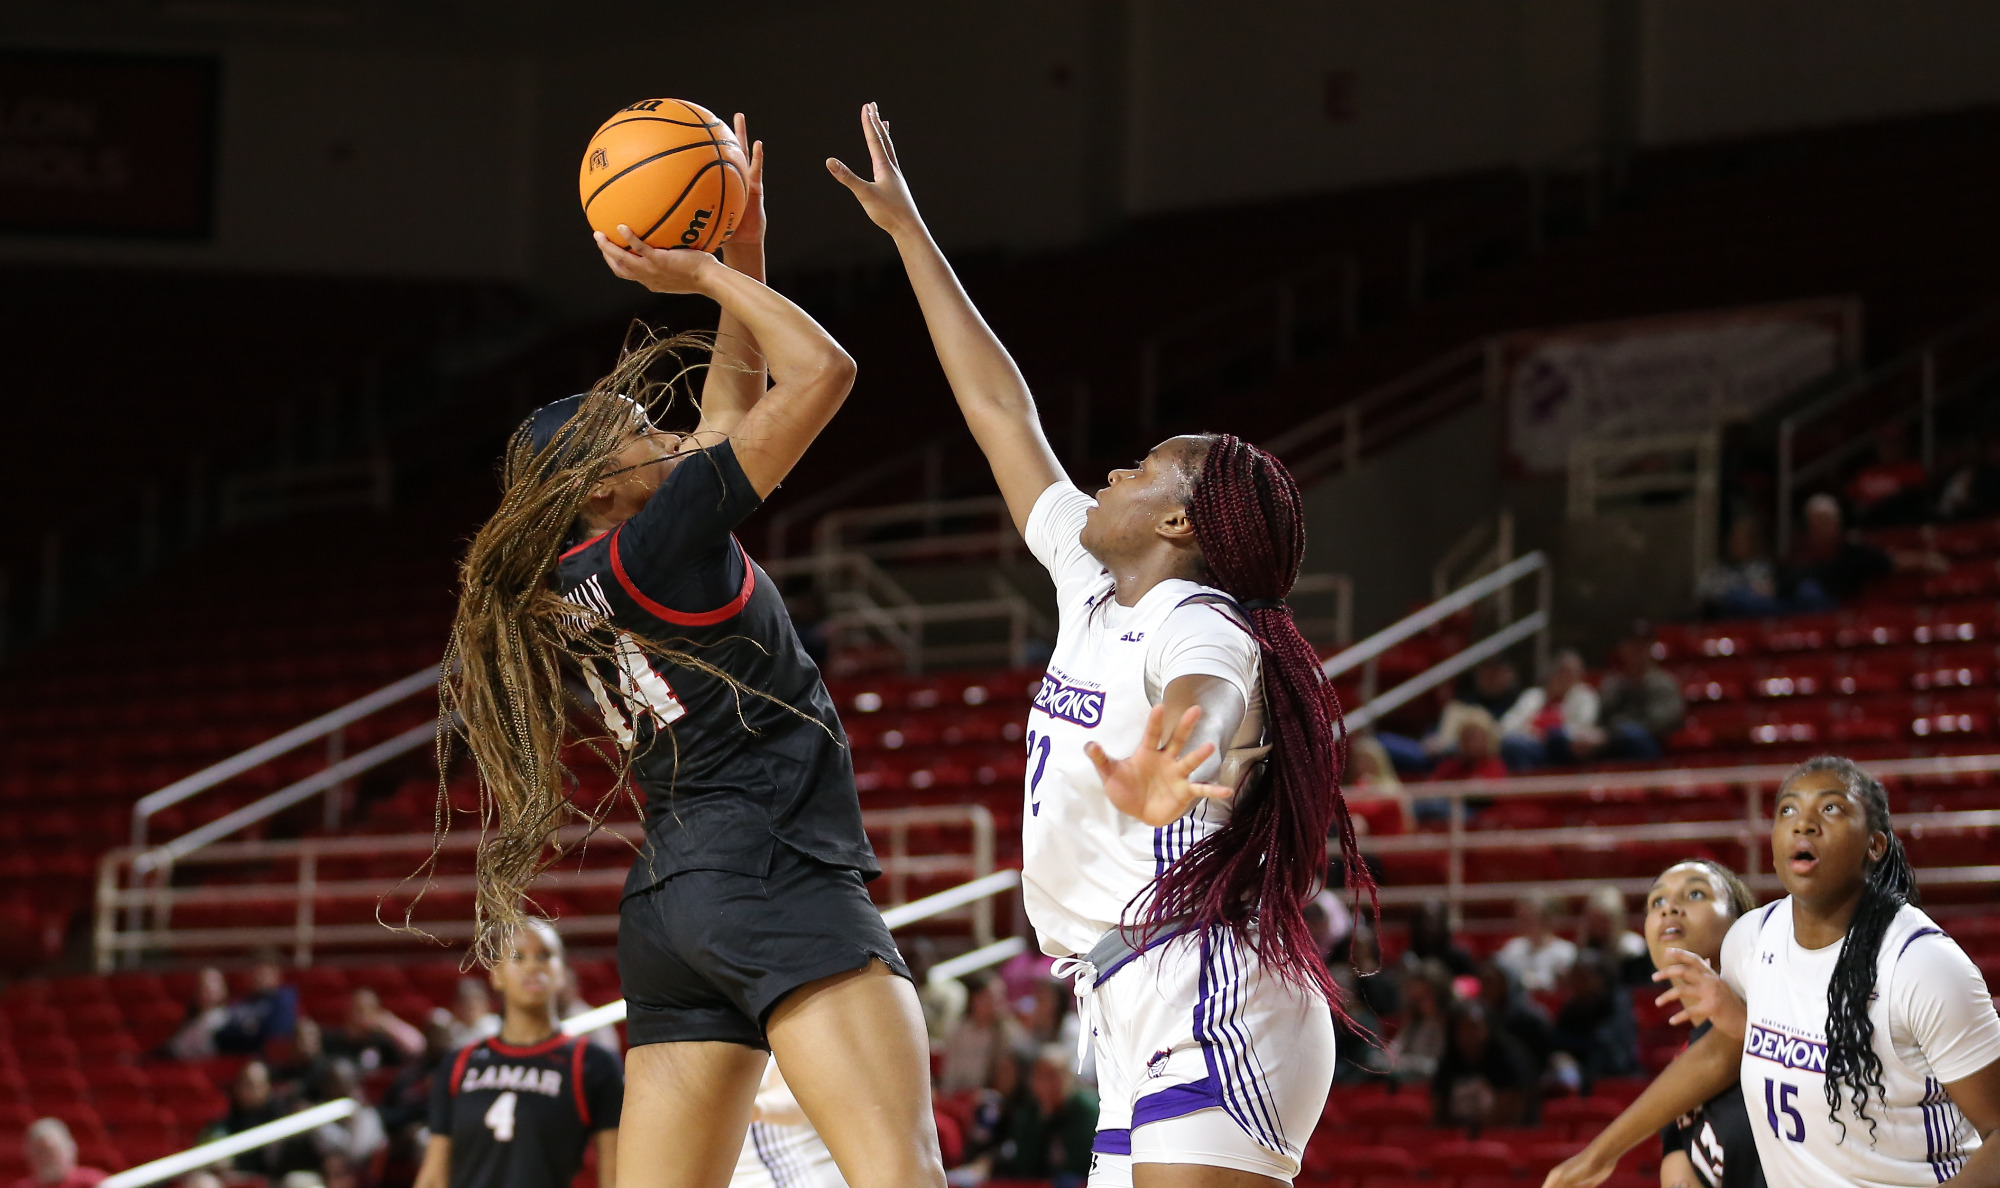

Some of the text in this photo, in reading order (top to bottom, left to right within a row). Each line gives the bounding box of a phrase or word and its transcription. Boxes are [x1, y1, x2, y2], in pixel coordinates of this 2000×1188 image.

[1747, 1026, 1833, 1072] DEMON
[461, 1064, 563, 1098] LAMAR
[484, 1091, 518, 1142] 4
[1764, 1077, 1806, 1143] 15
[1690, 1121, 1724, 1188] 13
